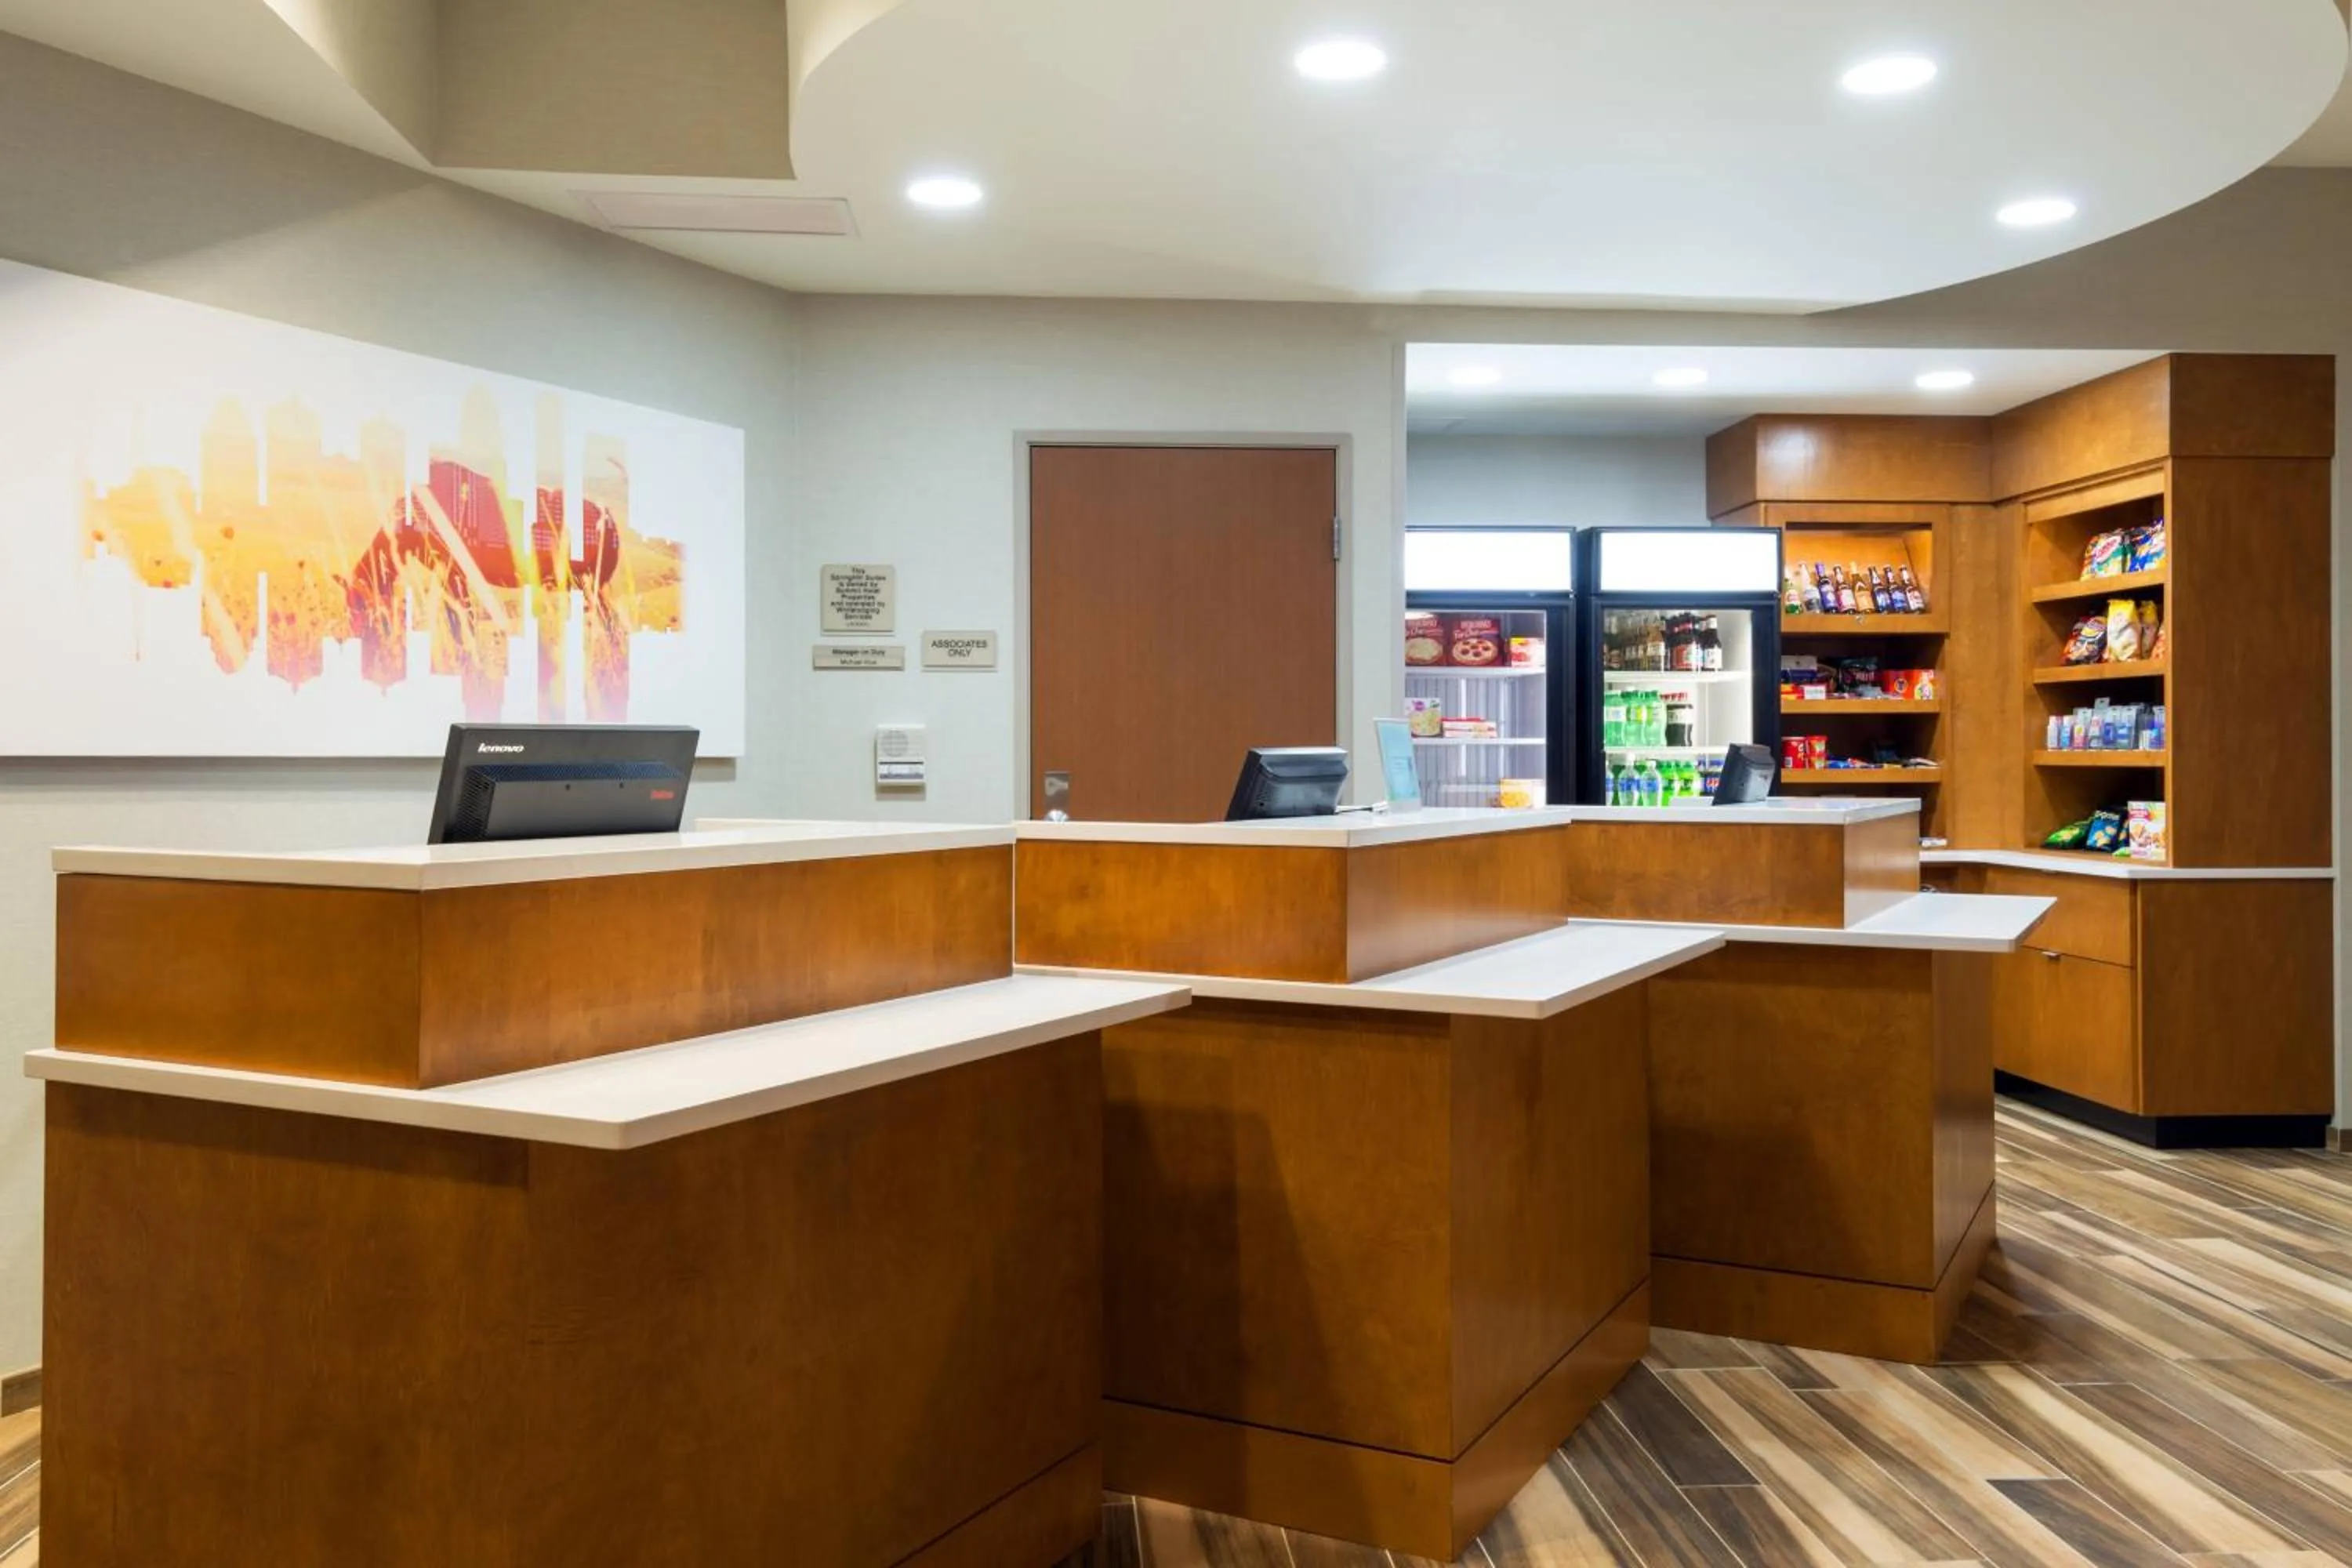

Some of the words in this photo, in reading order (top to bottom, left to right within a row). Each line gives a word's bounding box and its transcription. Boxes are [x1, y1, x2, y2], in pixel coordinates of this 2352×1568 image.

[931, 639, 988, 648] ASSOCIATES
[948, 648, 972, 657] ONLY
[478, 742, 524, 753] lenovo
